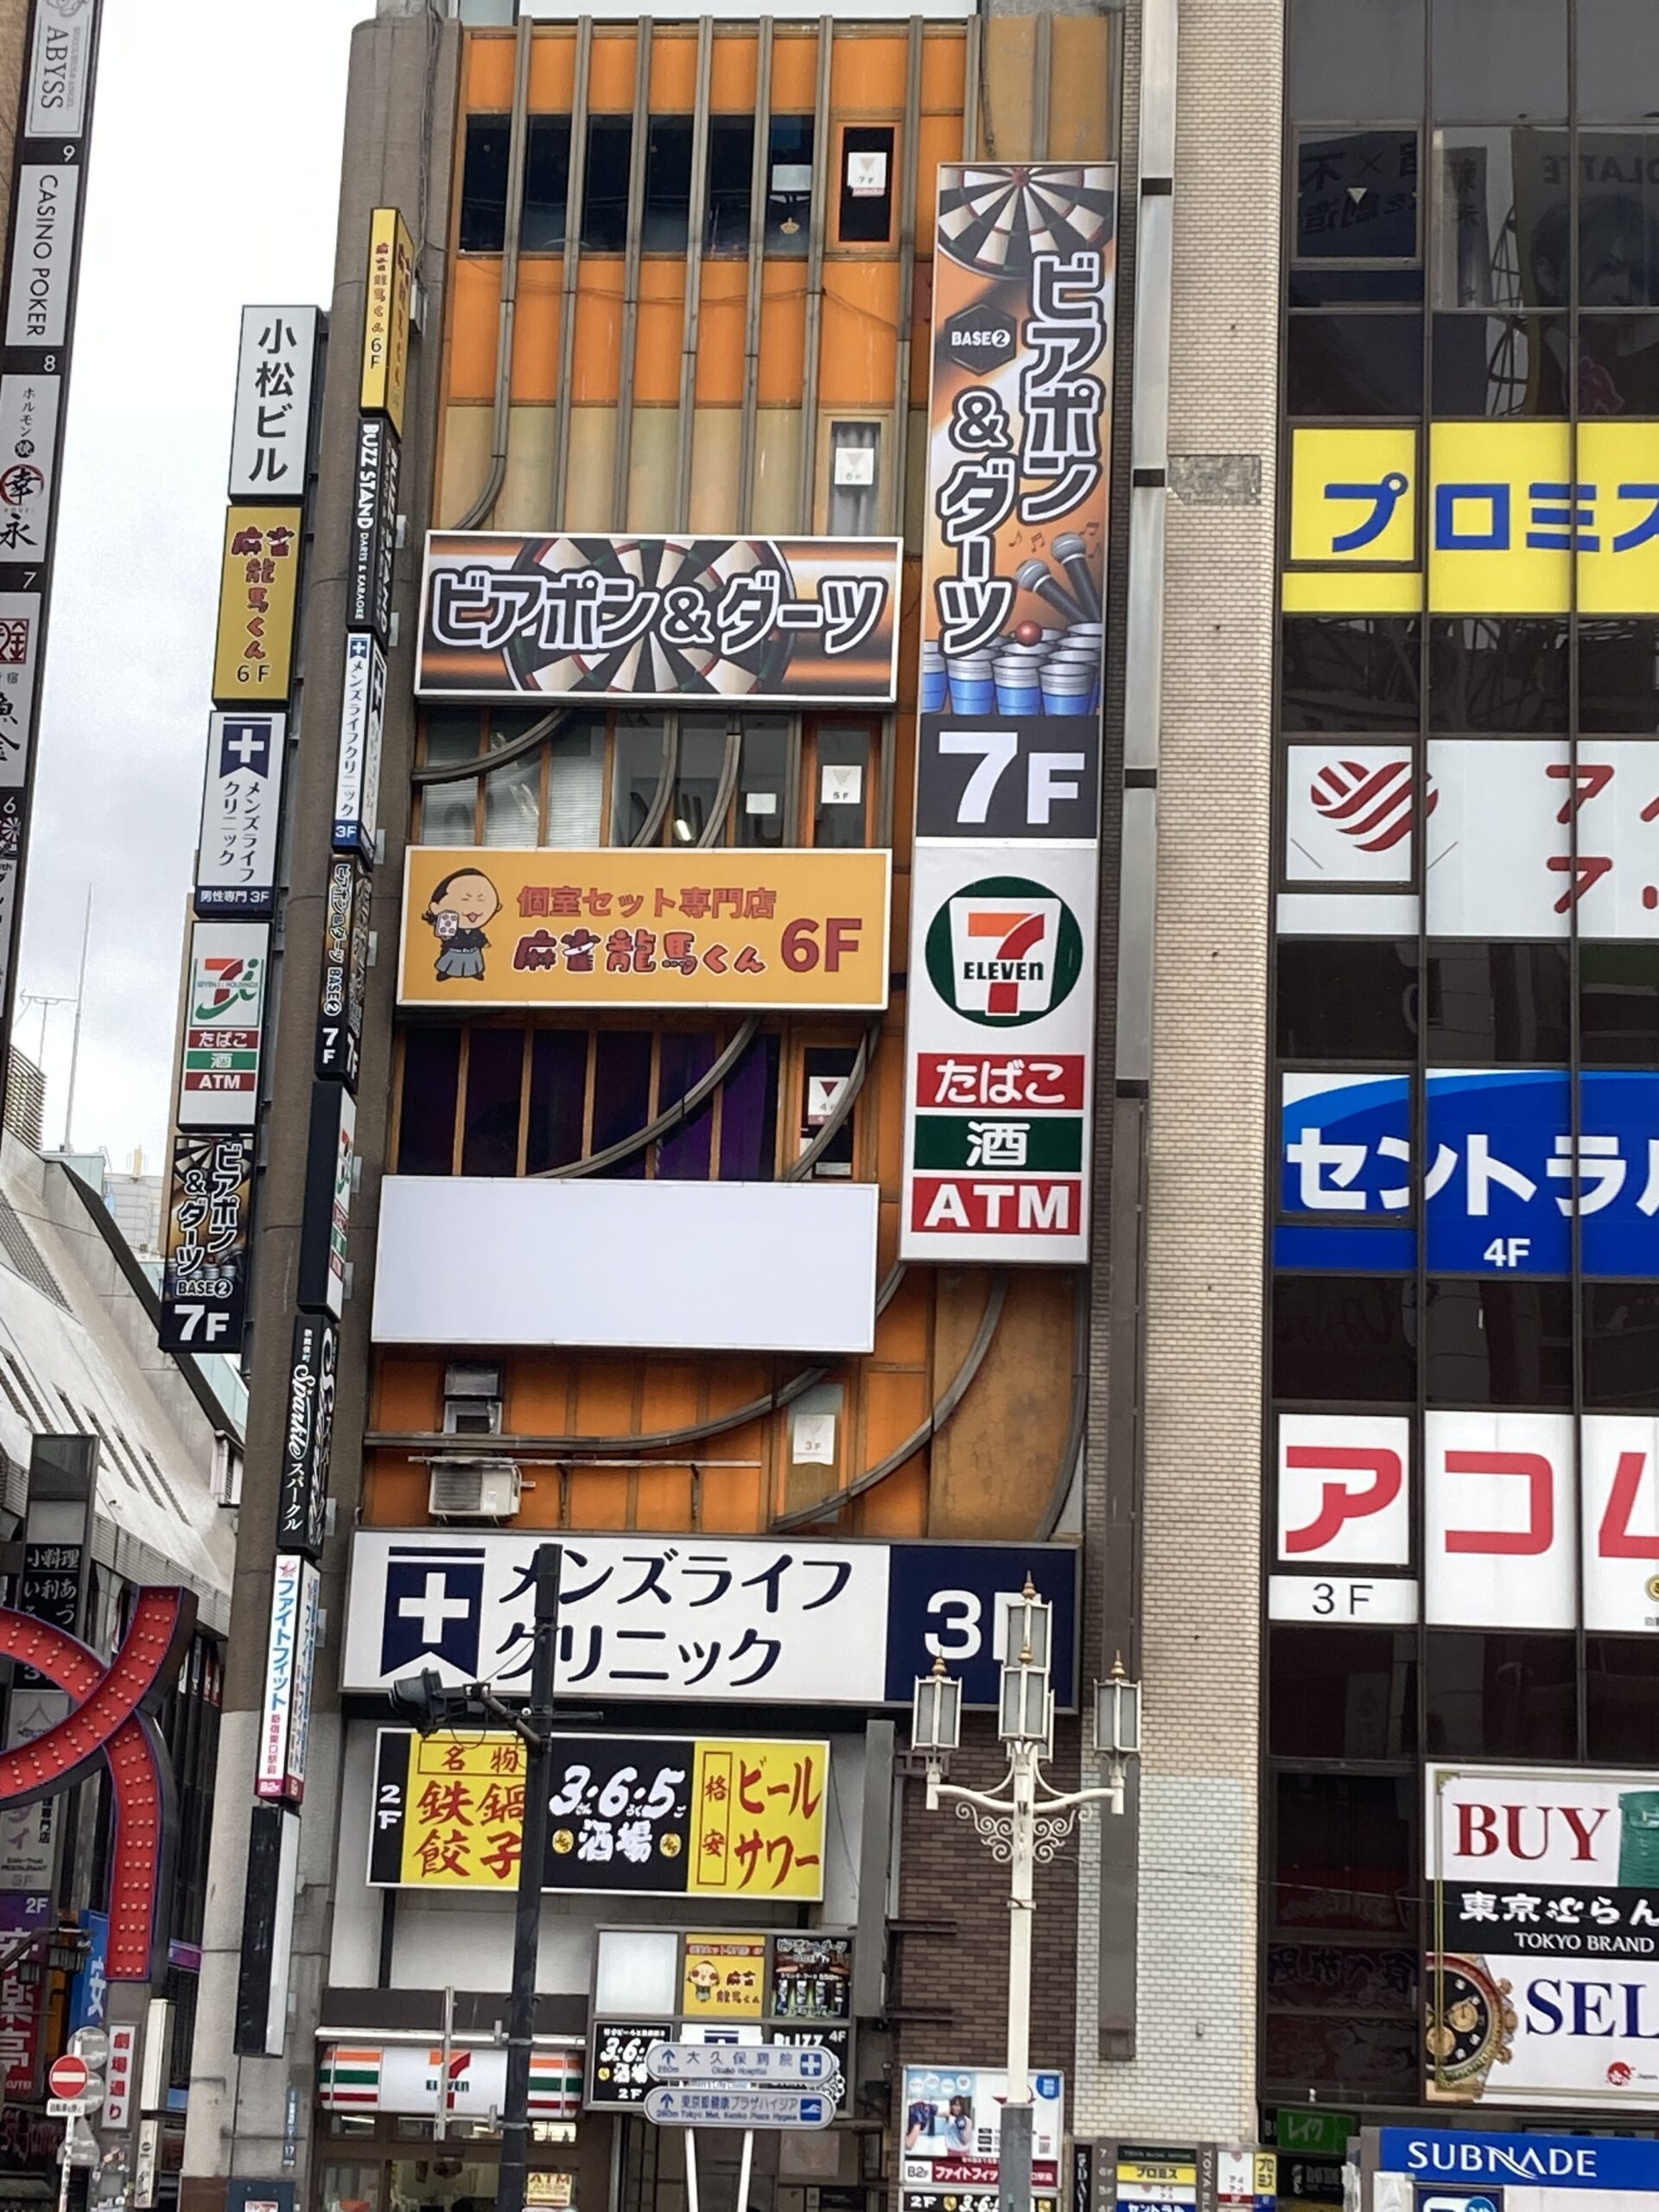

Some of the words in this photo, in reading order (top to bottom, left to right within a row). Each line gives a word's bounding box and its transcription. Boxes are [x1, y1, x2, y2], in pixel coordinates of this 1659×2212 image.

[41, 25, 69, 109] ABYSS
[63, 145, 75, 162] 9
[36, 175, 58, 259] CASINO
[27, 268, 50, 336] POKER
[43, 355, 56, 372] 8
[248, 317, 297, 483] 小松ビル
[1022, 251, 1103, 522] ビアポン
[360, 423, 379, 467] BUZZ
[356, 471, 377, 529] STAND
[940, 391, 1014, 655] &ダーツ
[22, 571, 37, 589] 7
[433, 569, 885, 655] ビアポン&ダーツ
[340, 660, 364, 817] メンズライフクリニック
[938, 732, 1085, 824] 7F
[3, 798, 16, 814] 6
[219, 781, 240, 867] クリニック
[240, 781, 261, 883] メンズライフ
[334, 825, 357, 839] 3F
[200, 890, 247, 904] 男性専門
[250, 891, 270, 904] 3F
[518, 886, 777, 920] 個室セット専門店
[512, 927, 767, 976] 麻雀龍馬くん
[780, 917, 862, 975] 6F
[199, 1031, 248, 1048] たばこ
[322, 1027, 340, 1065] 7F
[199, 1074, 240, 1090] ATM
[934, 1059, 1065, 1104] たばこ
[966, 1121, 1031, 1167] 酒
[207, 1142, 243, 1253] ビアポン
[924, 1184, 1071, 1230] ATM
[176, 1169, 208, 1276] &ダーツ
[1484, 1238, 1530, 1268] 4F
[174, 1304, 230, 1342] 7F
[283, 1463, 305, 1532] スパークル
[1312, 1582, 1374, 1617] 3F
[270, 1579, 295, 1711] ファイトフィット
[441, 1744, 519, 1773] 名物
[379, 1784, 402, 1829] 2F
[416, 1780, 525, 1827] 鉄鍋
[738, 1756, 823, 1819] ビール
[413, 1827, 522, 1879] 餃子
[577, 1819, 653, 1863] 酒場
[1452, 1802, 1611, 1862] BUY
[734, 1829, 820, 1891] サワー
[25, 1897, 48, 1913] 2F
[1514, 1932, 1582, 1950] TOKYO
[1586, 1933, 1656, 1953] BRAND
[685, 2050, 793, 2067] 大久保病院
[830, 2031, 846, 2042] 4F
[618, 2088, 642, 2100] 2F
[530, 2174, 569, 2184] ATM
[935, 2165, 999, 2181] ファイトフィッ
[1202, 2150, 1212, 2188] TOYA
[1408, 2141, 1598, 2181] SUBNADE
[910, 2195, 938, 2209] 2F
